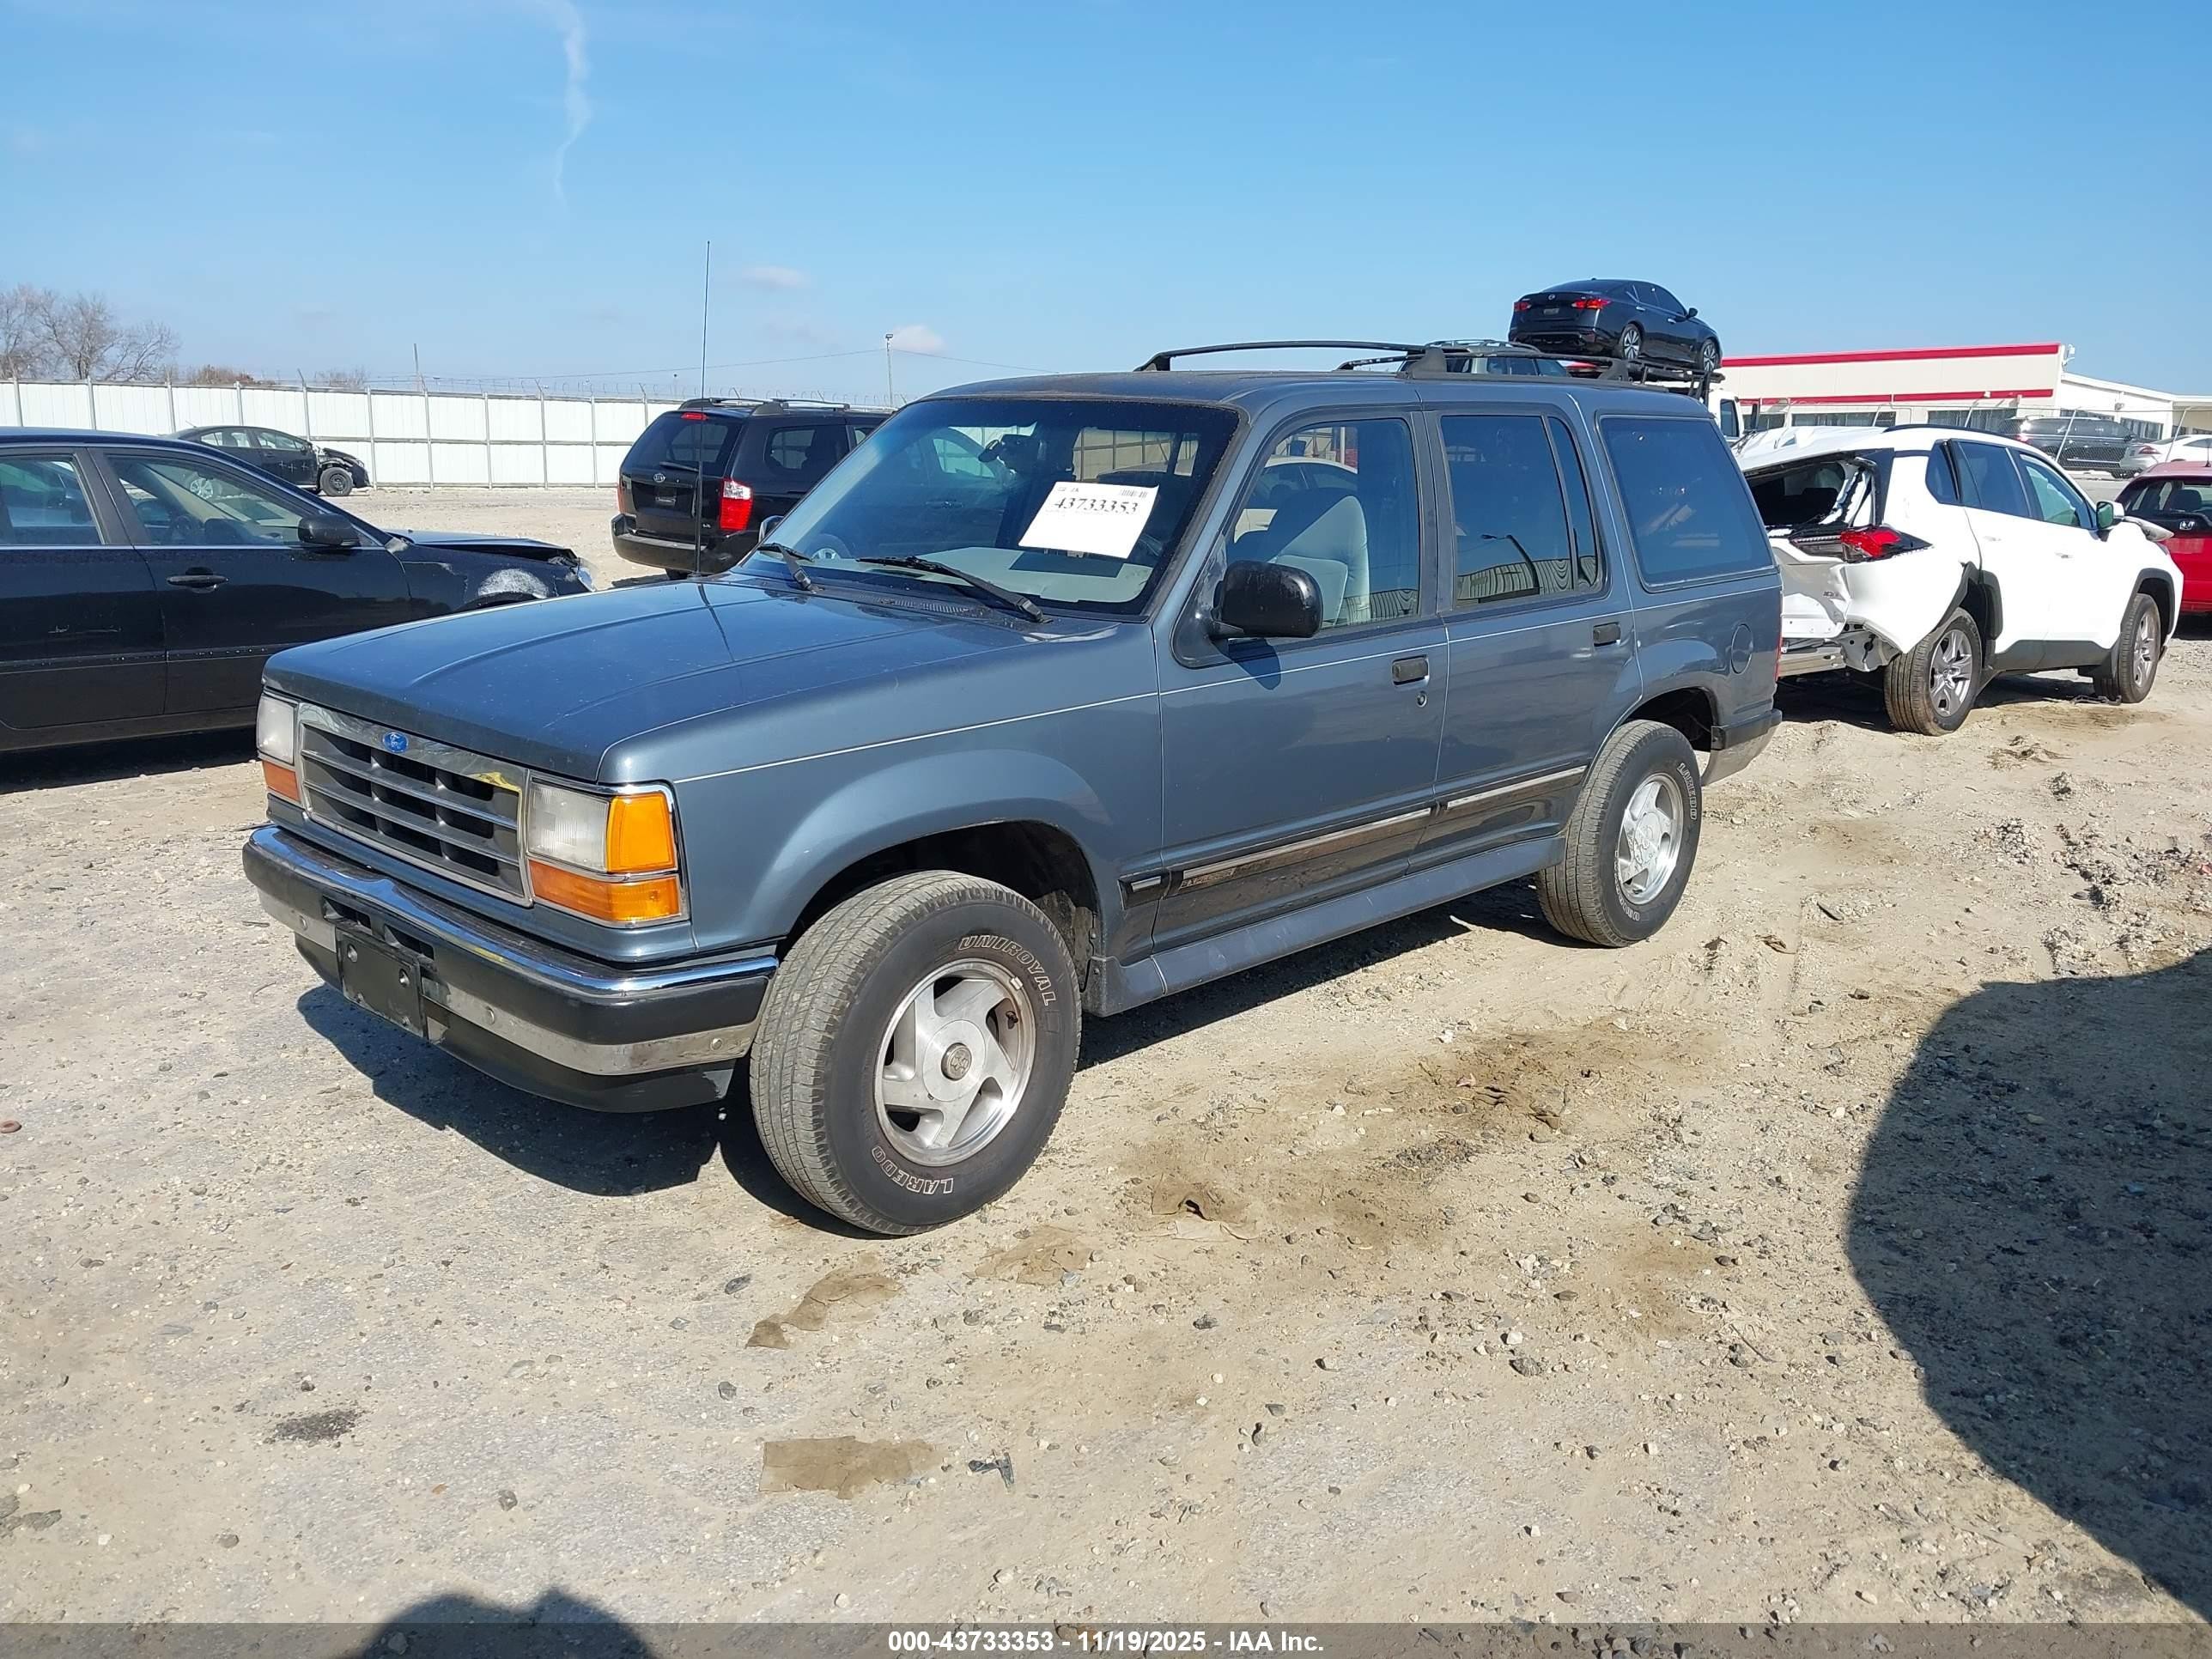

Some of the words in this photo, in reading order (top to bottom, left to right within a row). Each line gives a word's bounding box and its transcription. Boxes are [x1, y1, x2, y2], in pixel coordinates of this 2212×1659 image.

[1054, 497, 1139, 515] 43733353
[957, 933, 1058, 1007] UNIROYAL
[871, 1145, 955, 1195] LAREDO
